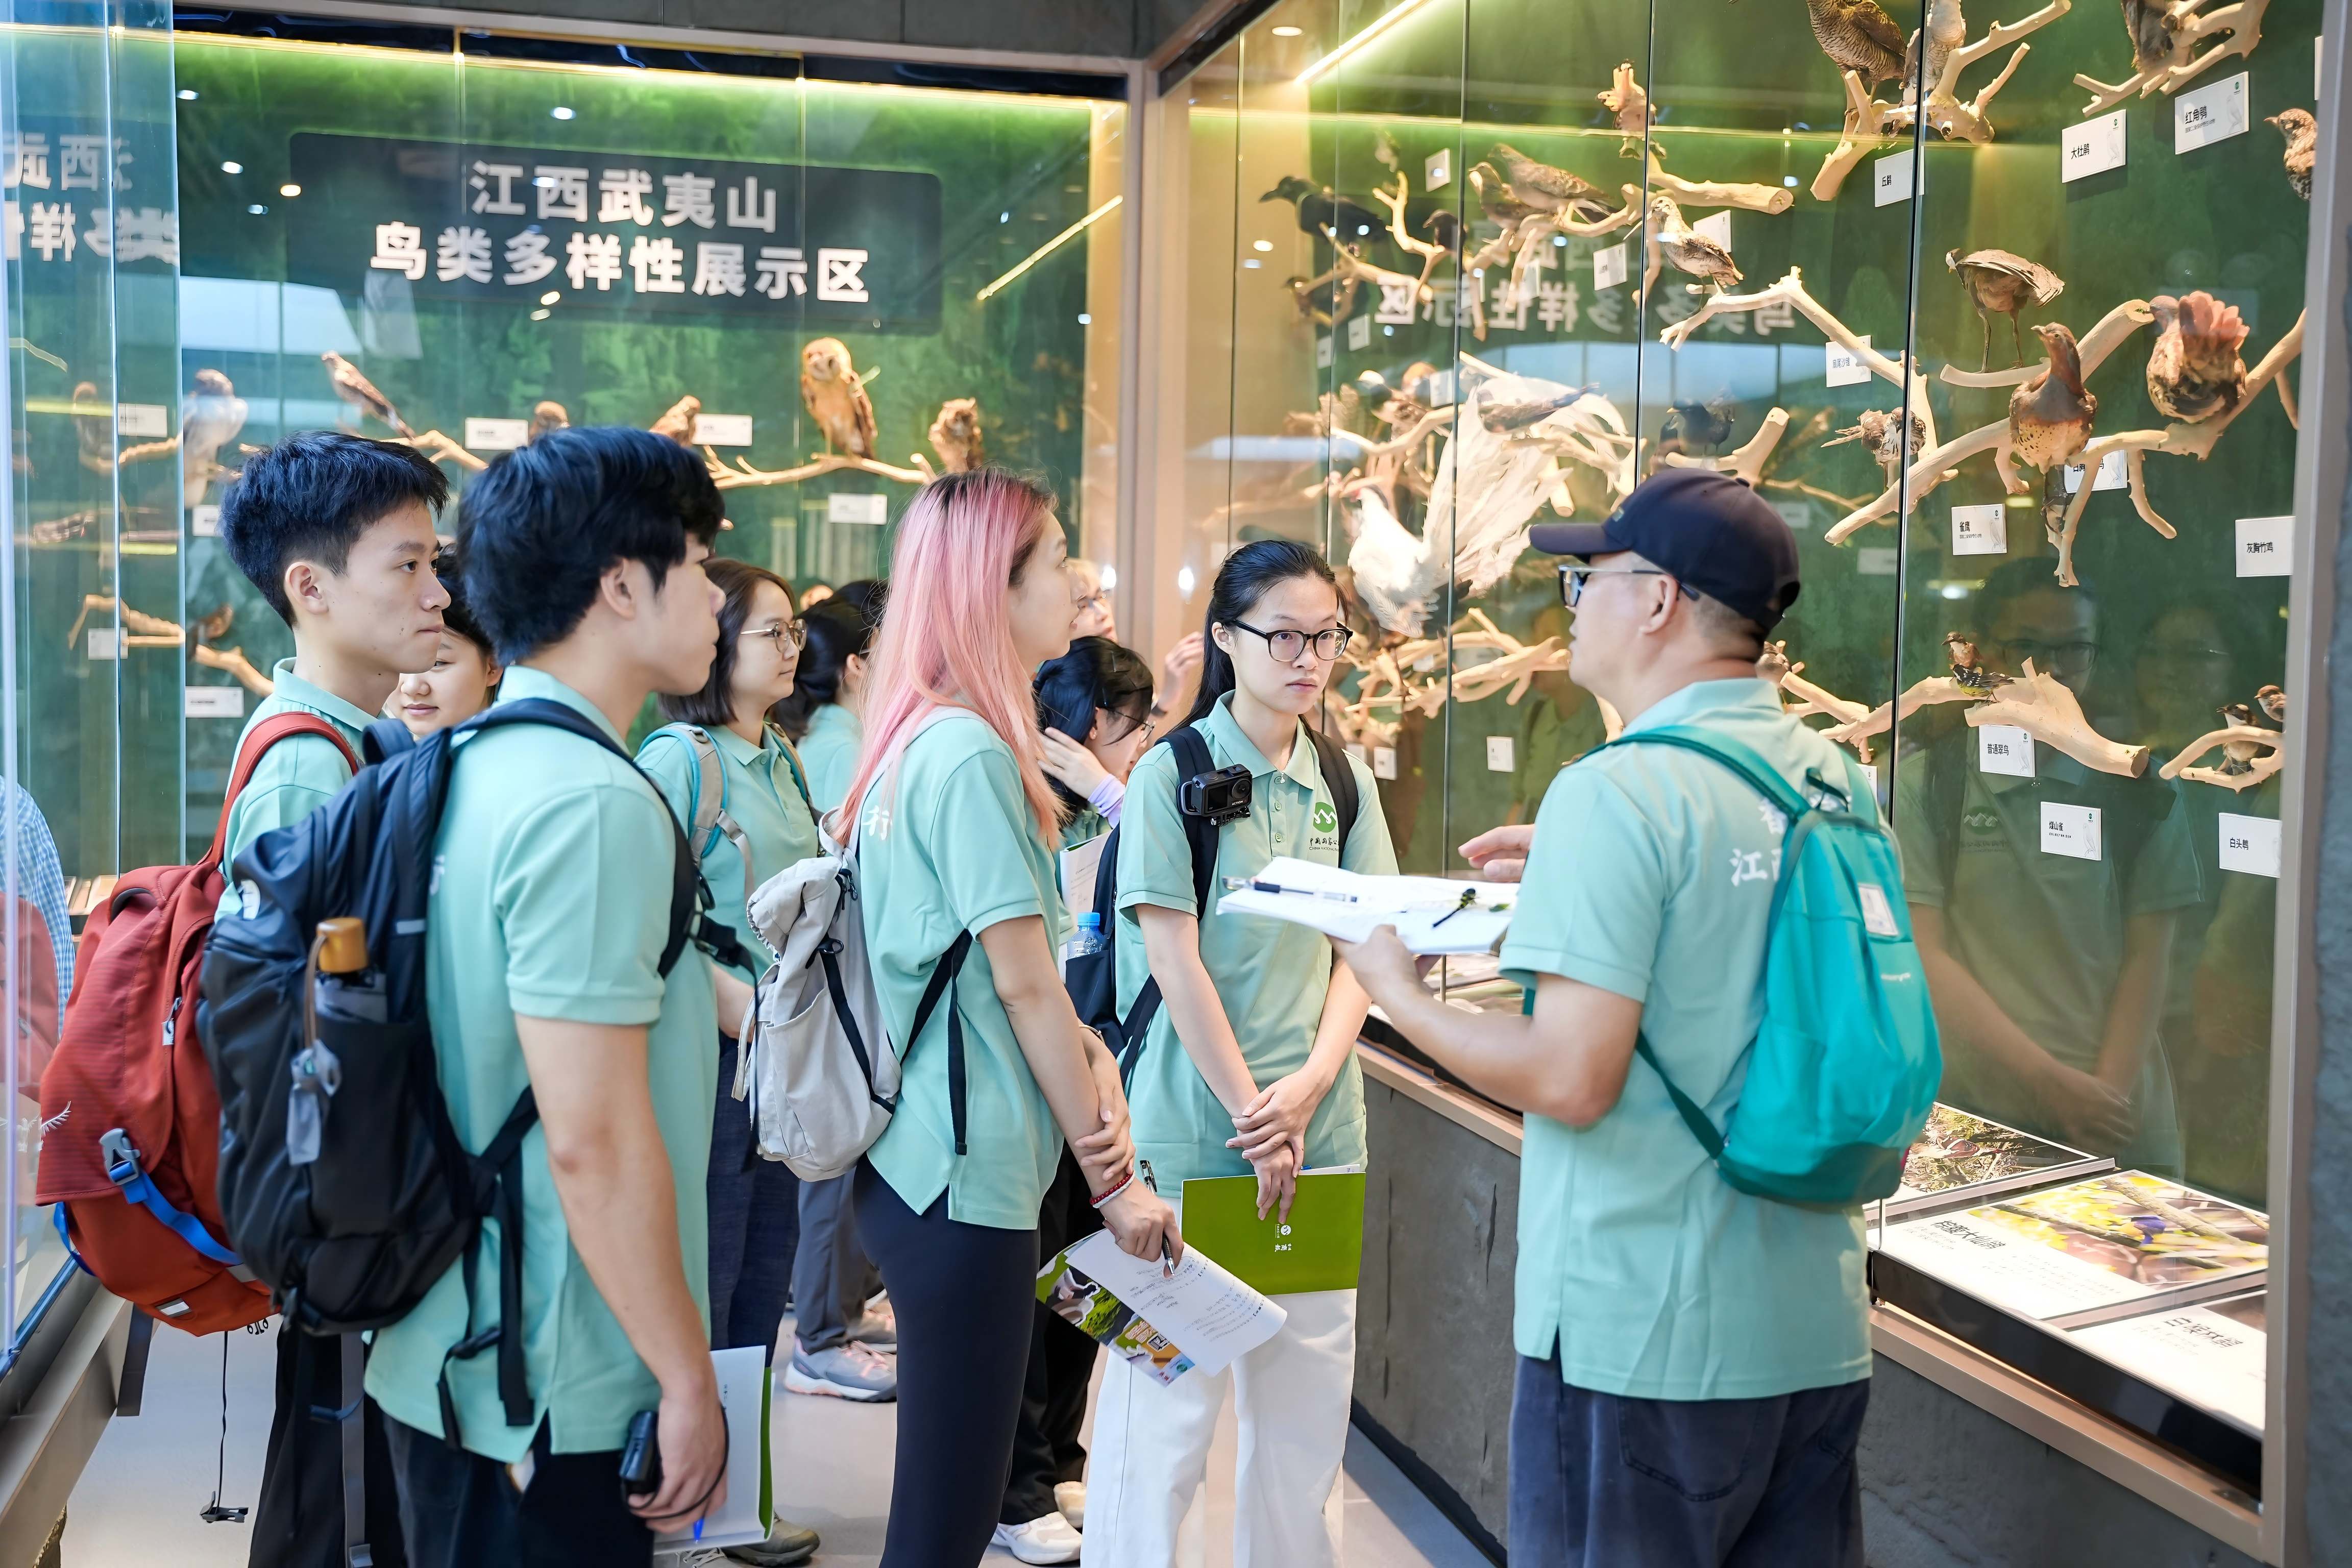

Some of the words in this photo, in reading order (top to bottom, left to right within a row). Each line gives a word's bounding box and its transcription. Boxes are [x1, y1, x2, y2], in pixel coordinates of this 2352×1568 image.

[2071, 142, 2090, 159] 大杜鹃
[469, 160, 776, 233] 江西武夷山
[370, 222, 869, 303] 鸟类多样性展示区
[1959, 521, 1970, 532] 雀鹰
[2246, 541, 2273, 553] 灰胸竹鸡
[1987, 743, 2009, 755] 普通翠鸟
[862, 805, 893, 841] 行
[2049, 821, 2063, 831] 煤山雀
[1310, 837, 1339, 846] 中国国家公
[2230, 837, 2249, 850] 白头鹎
